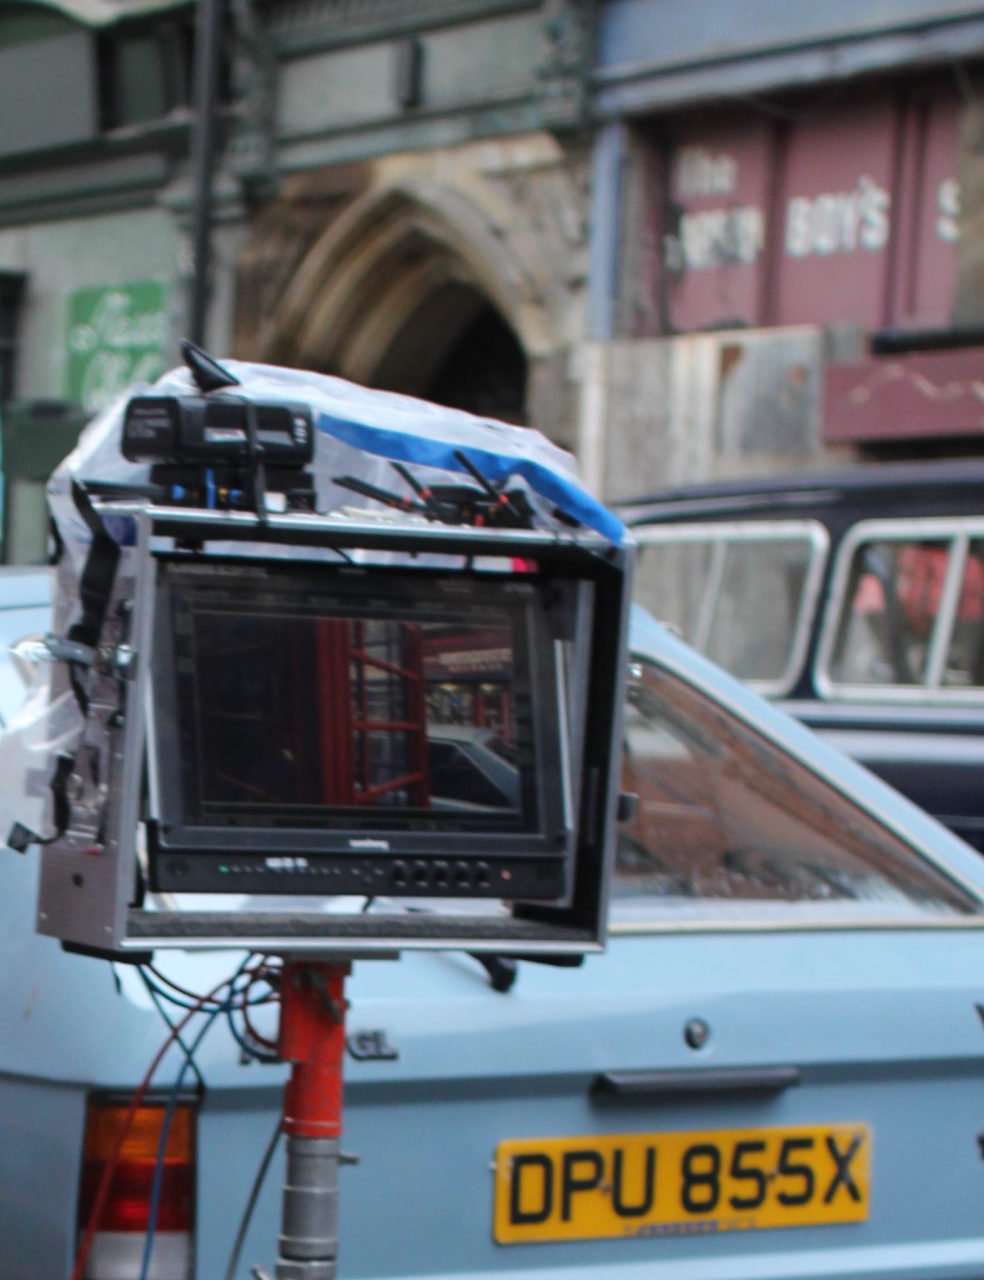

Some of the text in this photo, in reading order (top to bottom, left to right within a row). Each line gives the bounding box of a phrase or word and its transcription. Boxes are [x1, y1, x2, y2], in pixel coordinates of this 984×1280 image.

[785, 173, 890, 258] BOY'S
[509, 1133, 864, 1227] DPU 855X
